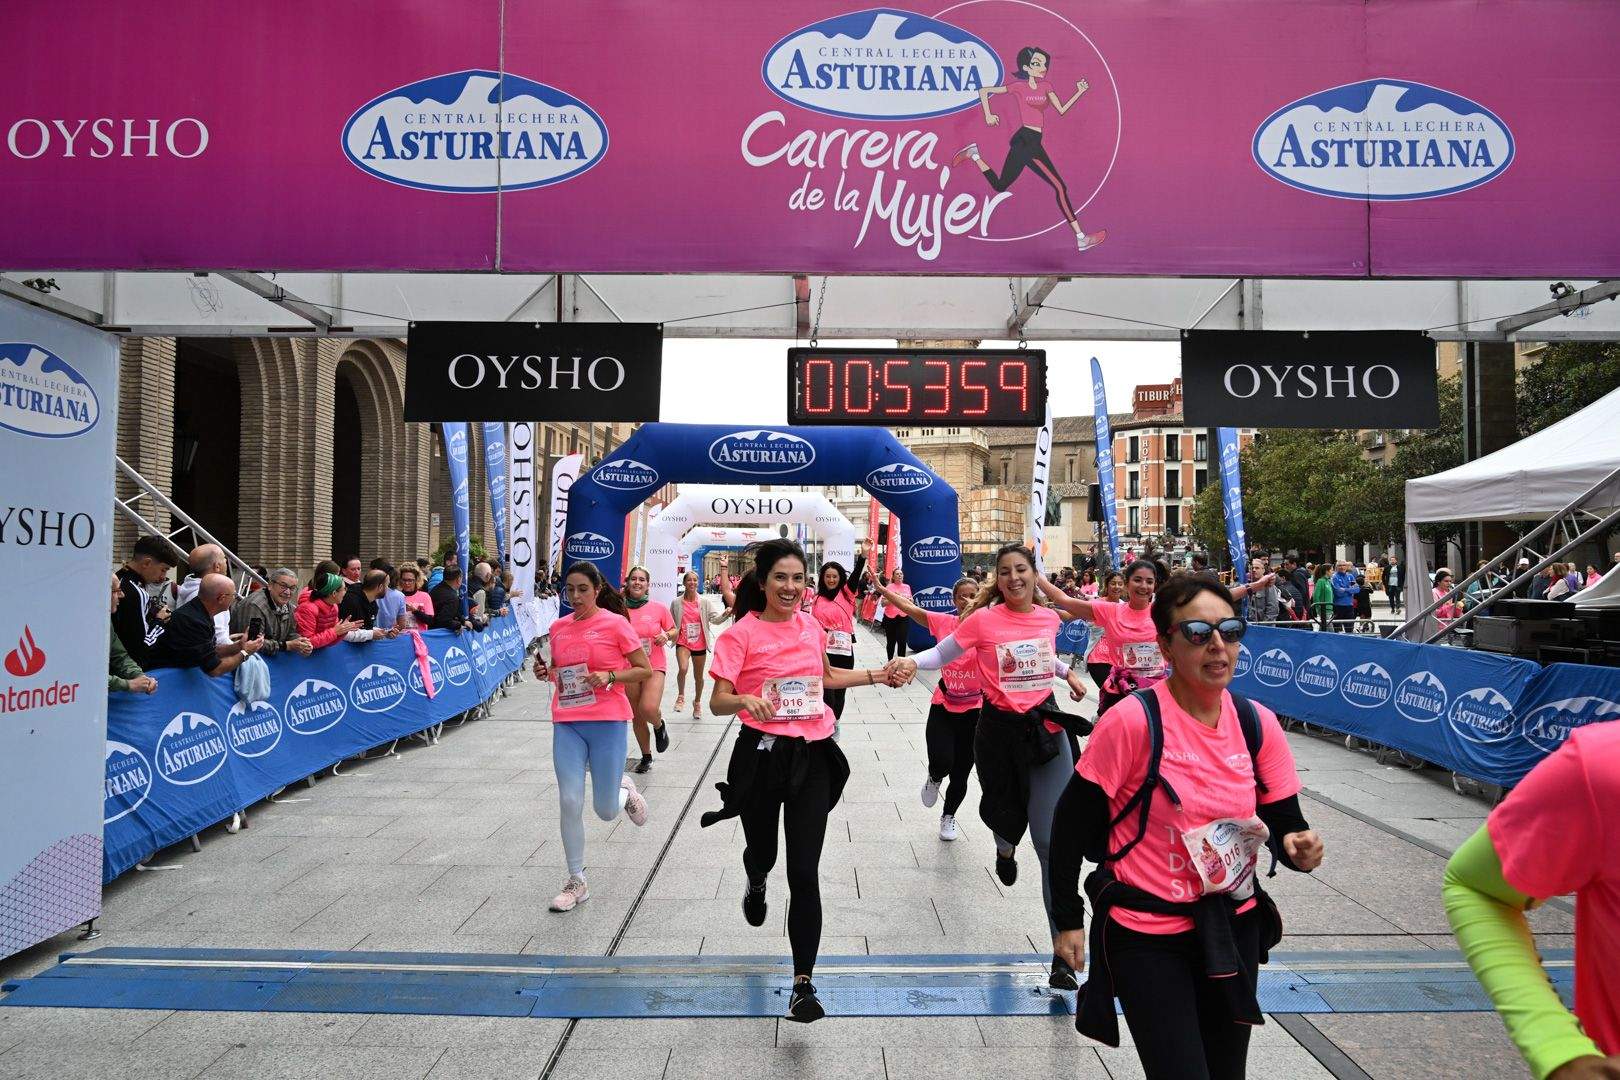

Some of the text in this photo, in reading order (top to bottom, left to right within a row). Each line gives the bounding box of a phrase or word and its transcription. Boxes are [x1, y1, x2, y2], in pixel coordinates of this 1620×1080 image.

[819, 47, 977, 59] CENTRAL LECHERA
[781, 49, 983, 91] ASTURIANA
[404, 113, 580, 125] CENTRAL LECHERA
[1314, 121, 1486, 132] CENTRAL LECHERA
[7, 118, 209, 159] OYSHO
[362, 116, 588, 161] ASTURIANA
[741, 111, 938, 170] Carrera
[1273, 124, 1495, 168] ASTURIANA
[789, 166, 1013, 260] de la Mujer
[448, 354, 625, 391] OYSHO
[1224, 364, 1400, 399] OYSHO
[44, 380, 88, 397] LECHERA
[1138, 391, 1170, 402] TIBUR
[717, 443, 807, 464] ASTURIANA
[597, 470, 653, 483] ASTURIANA
[872, 475, 929, 486] ASTURIANA
[513, 423, 531, 567] OYSHO
[711, 498, 793, 515] OYSHO
[567, 541, 610, 554] ASTURIANA
[1018, 660, 1037, 669] 016
[1256, 660, 1289, 680] ASTURIANA
[1298, 667, 1334, 688] ASTURIANA
[1343, 676, 1387, 700] ASTURIANA
[356, 682, 403, 705] ASTURIANA
[783, 699, 803, 707] 016
[1397, 686, 1442, 714] ASTURIANA
[291, 698, 343, 726] ASTURIANA
[171, 737, 195, 749] CENTRAL
[231, 719, 279, 746] ASTURIANA
[109, 757, 138, 772] LECHERA
[164, 737, 225, 775] ASTURIANA
[1224, 843, 1240, 866] 016
